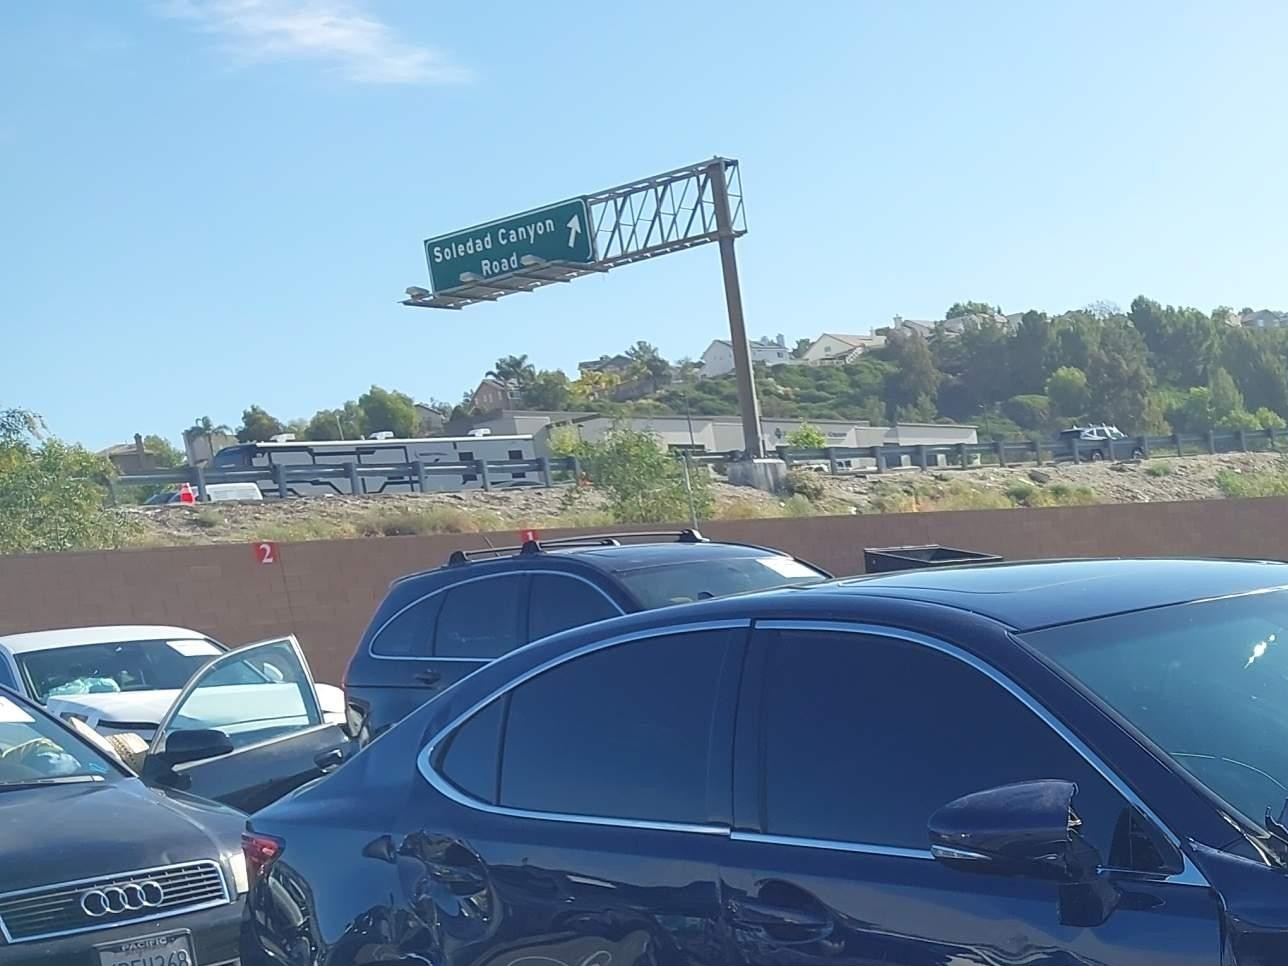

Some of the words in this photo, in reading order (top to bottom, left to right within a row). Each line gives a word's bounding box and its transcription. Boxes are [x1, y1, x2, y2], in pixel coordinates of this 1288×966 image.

[433, 233, 492, 262] Soledad
[498, 219, 555, 245] Canyon
[481, 252, 518, 276] Road
[259, 543, 274, 564] 2
[121, 937, 168, 951] PACIFIC
